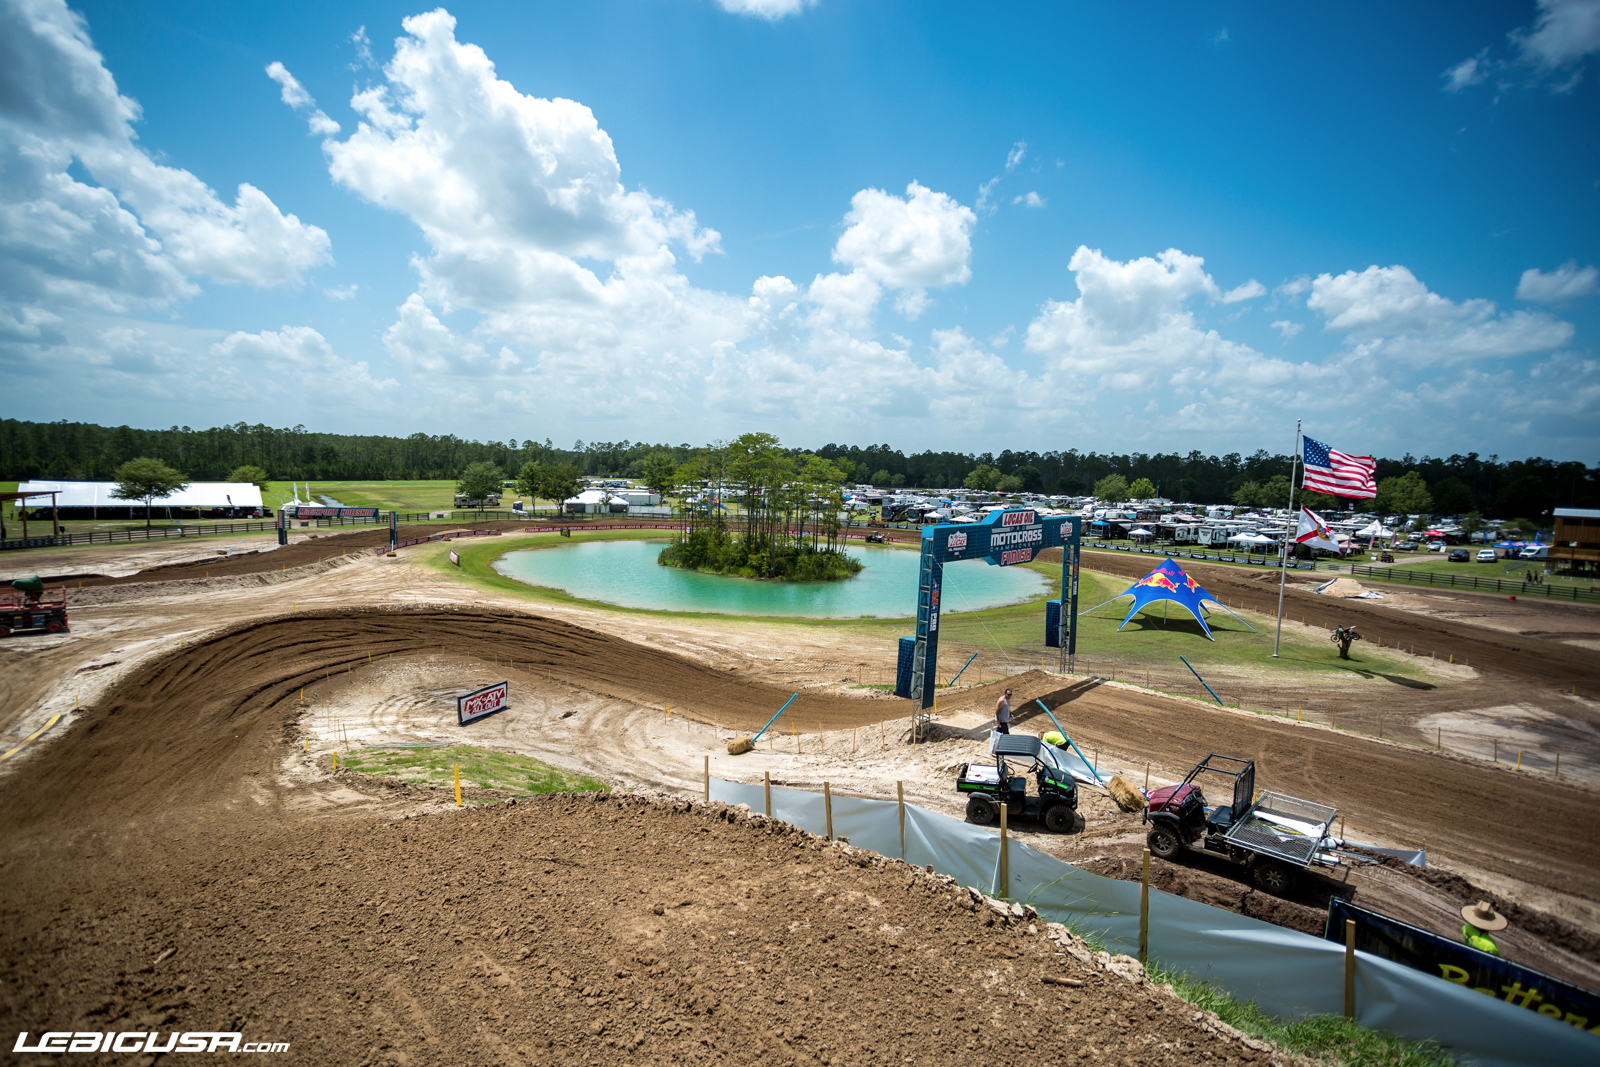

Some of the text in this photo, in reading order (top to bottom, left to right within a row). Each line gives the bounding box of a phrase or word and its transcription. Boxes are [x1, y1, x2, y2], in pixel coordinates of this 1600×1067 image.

[1003, 512, 1034, 525] LUCAS OIL
[990, 529, 1043, 547] MOTOCROSS
[990, 540, 1043, 552] CHAMPIONSHIP
[1001, 548, 1032, 565] FINISH
[466, 695, 483, 711] MX
[484, 689, 504, 704] ATV
[471, 699, 499, 714] ALL OUT
